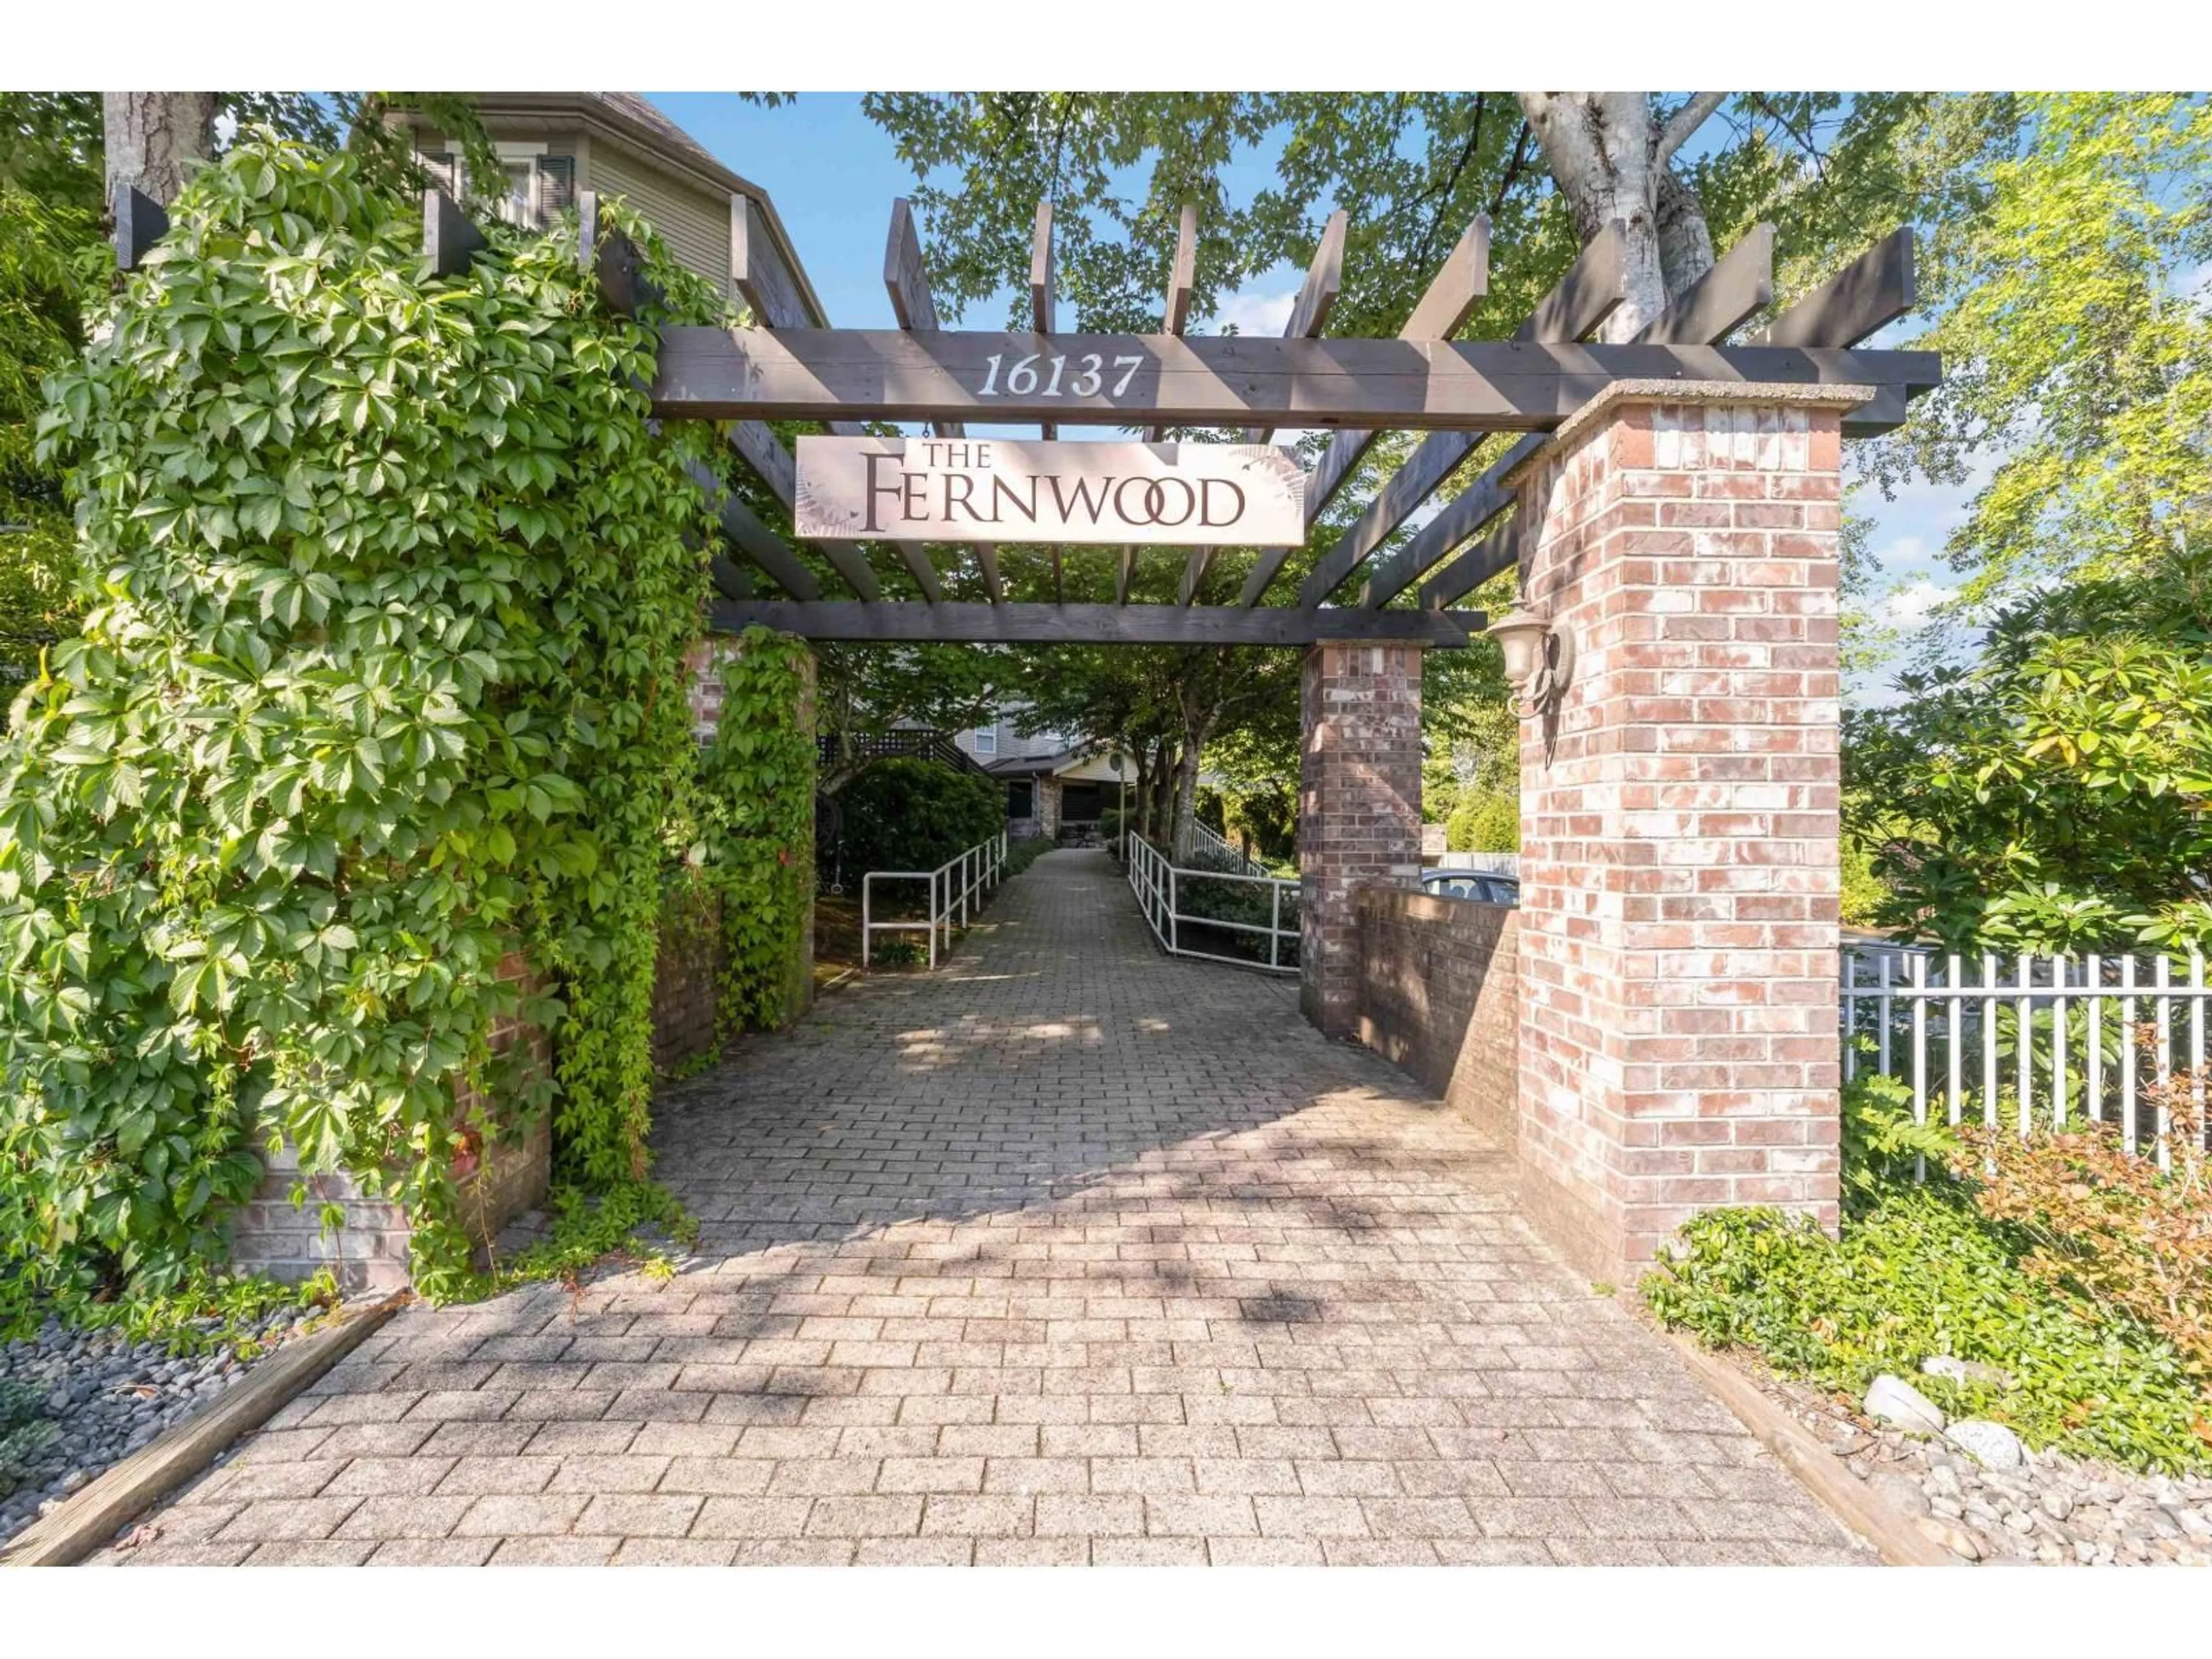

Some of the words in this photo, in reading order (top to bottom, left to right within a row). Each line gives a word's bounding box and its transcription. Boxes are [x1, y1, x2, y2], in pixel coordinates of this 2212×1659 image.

[978, 353, 1143, 397] 16137
[922, 443, 991, 468] THE
[859, 453, 1245, 532] FERNWOOD
